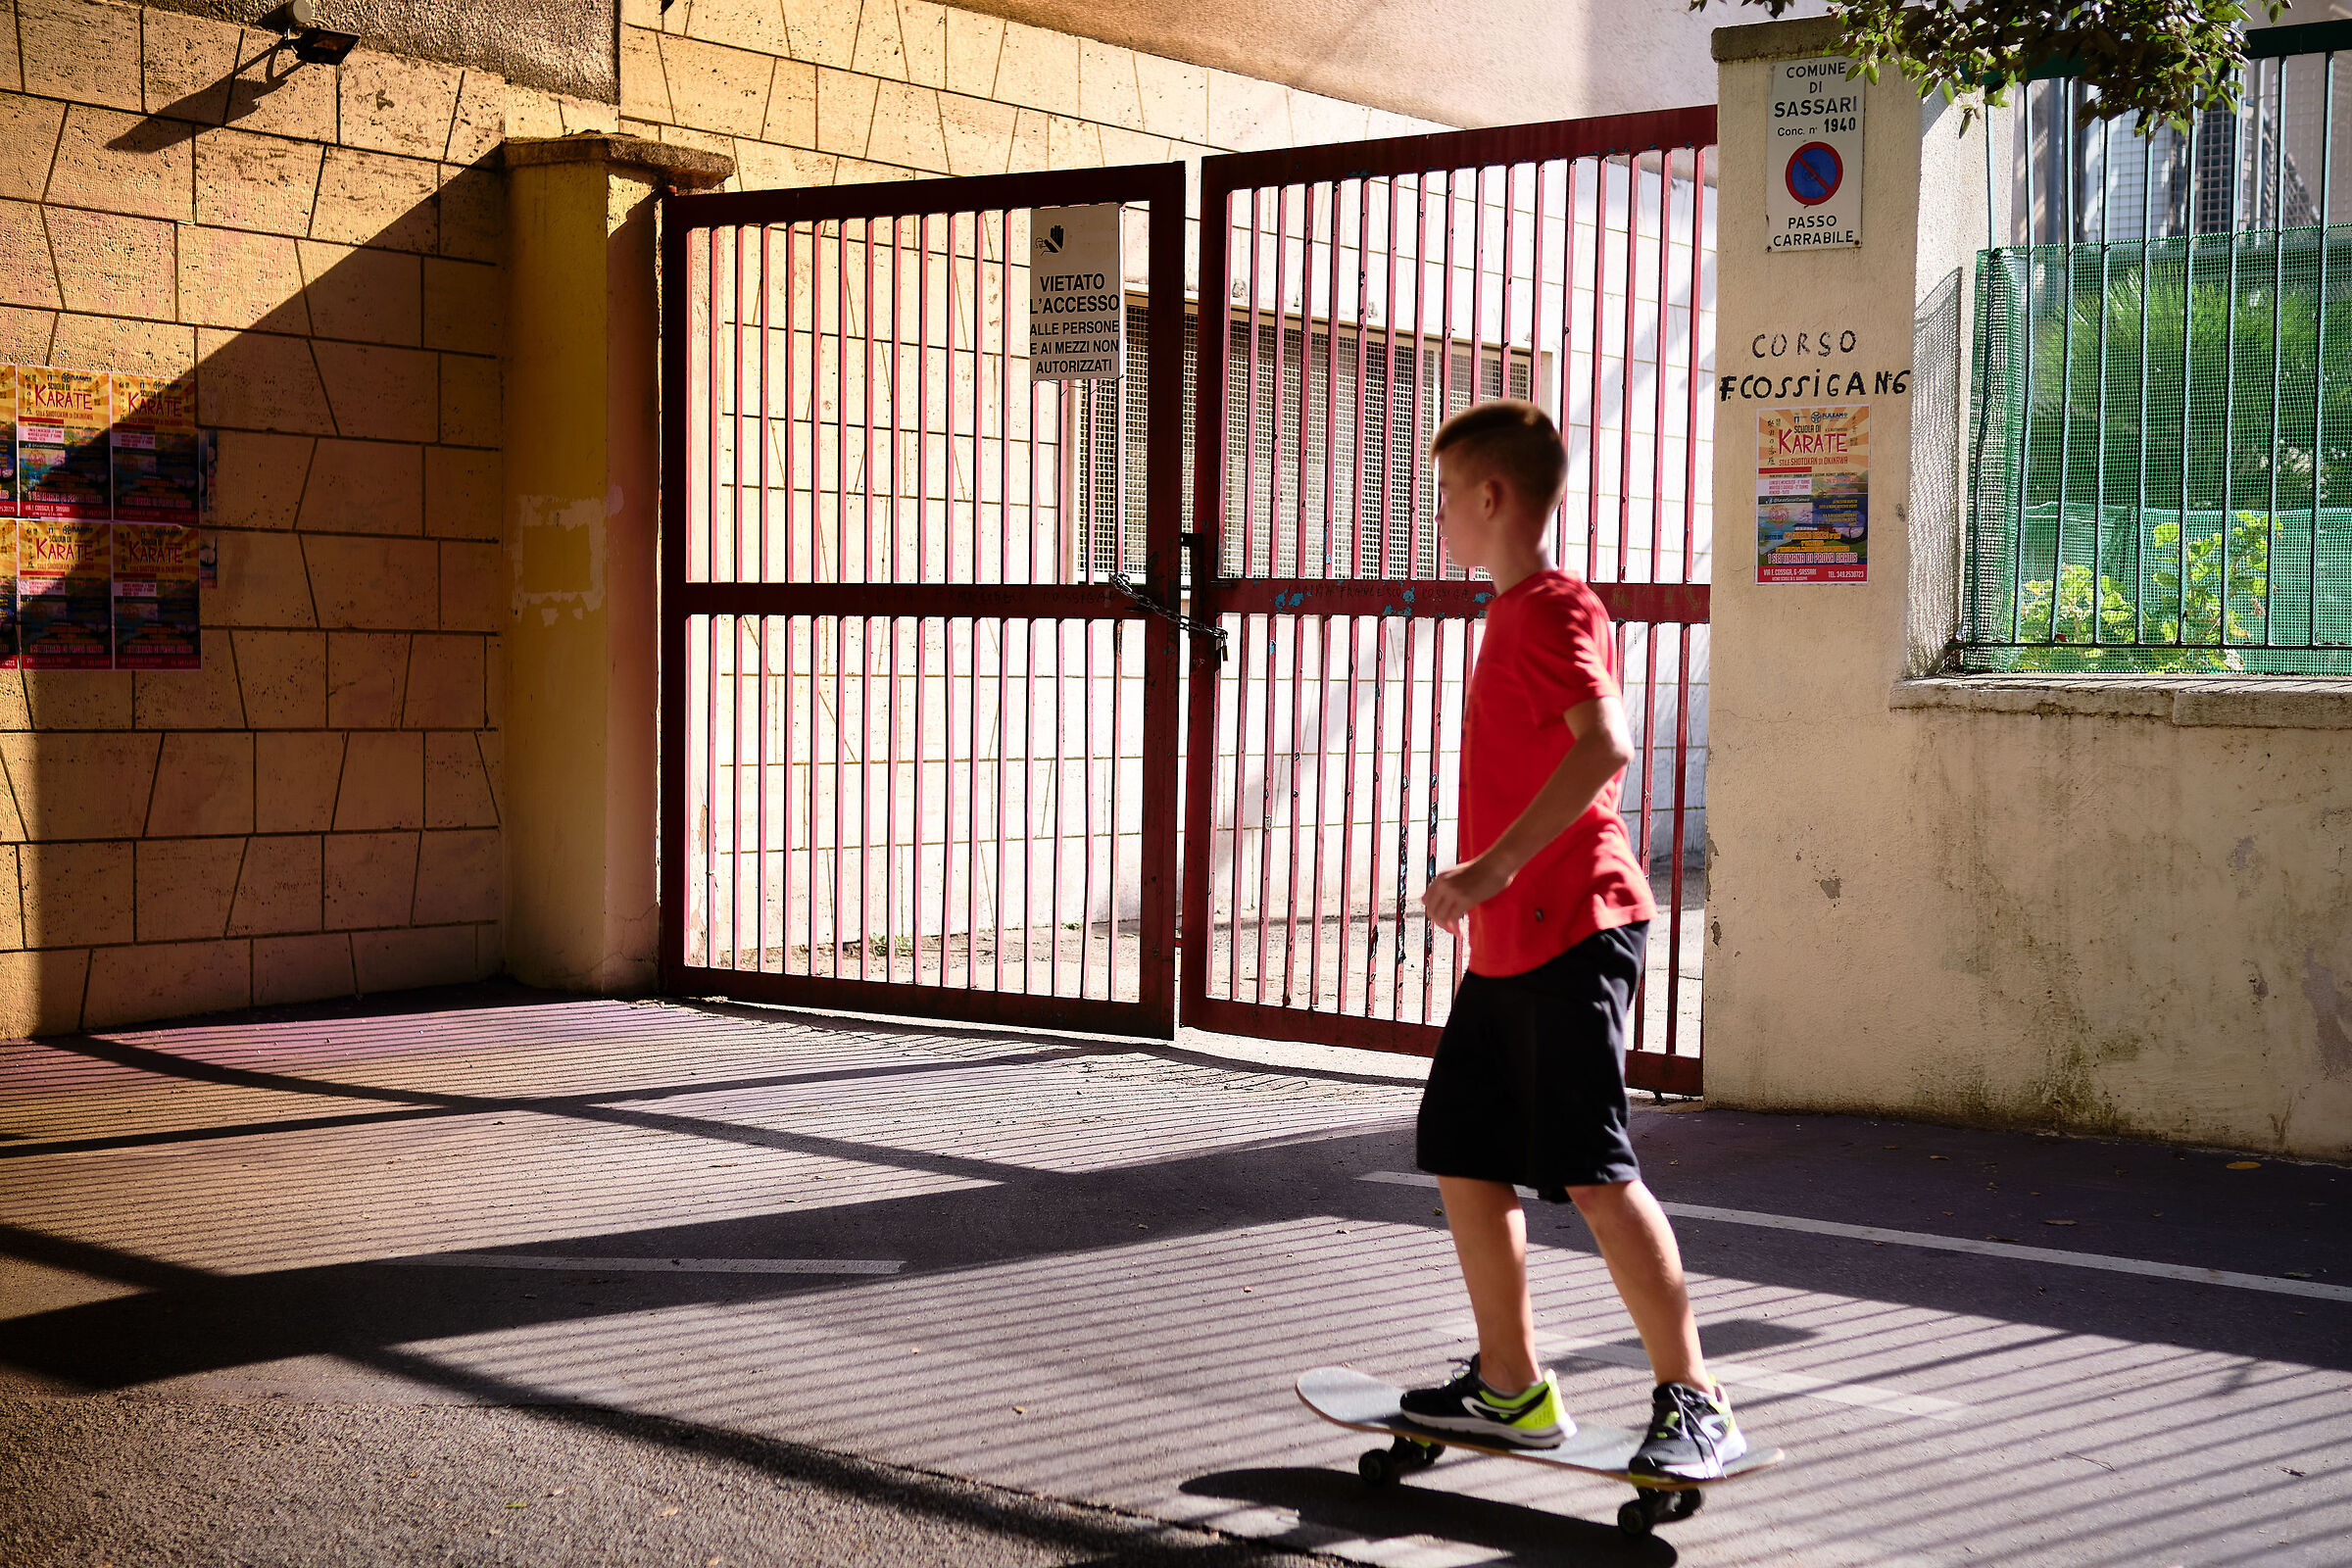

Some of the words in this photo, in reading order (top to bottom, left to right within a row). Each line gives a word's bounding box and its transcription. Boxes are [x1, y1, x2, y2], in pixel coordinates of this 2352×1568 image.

[1787, 62, 1847, 78] COMUNE
[1809, 81, 1822, 94] DI
[1774, 96, 1857, 118] SASSARI
[1777, 126, 1805, 137] Conc.
[1824, 117, 1856, 133] 1940
[1788, 215, 1838, 229] PASSO
[1773, 230, 1854, 247] CARRABILE
[1040, 272, 1105, 292] VIETATO
[1030, 294, 1120, 315] L'ACCESSO
[1030, 321, 1059, 336] ALLE
[1062, 319, 1120, 335] PERSONE
[1030, 342, 1038, 355] E
[1040, 341, 1052, 355] AI
[1054, 340, 1090, 354] MEZZI
[1093, 338, 1119, 353] NON
[1752, 329, 1857, 359] CORSO
[1035, 359, 1112, 374] AUTORIZZATI
[34, 384, 93, 411] KARATE
[128, 391, 182, 417] KARATE
[1794, 424, 1814, 434] SCUOLA
[1779, 427, 1848, 455] KARATE
[36, 537, 94, 562] KARATE
[129, 540, 183, 565] KARATE
